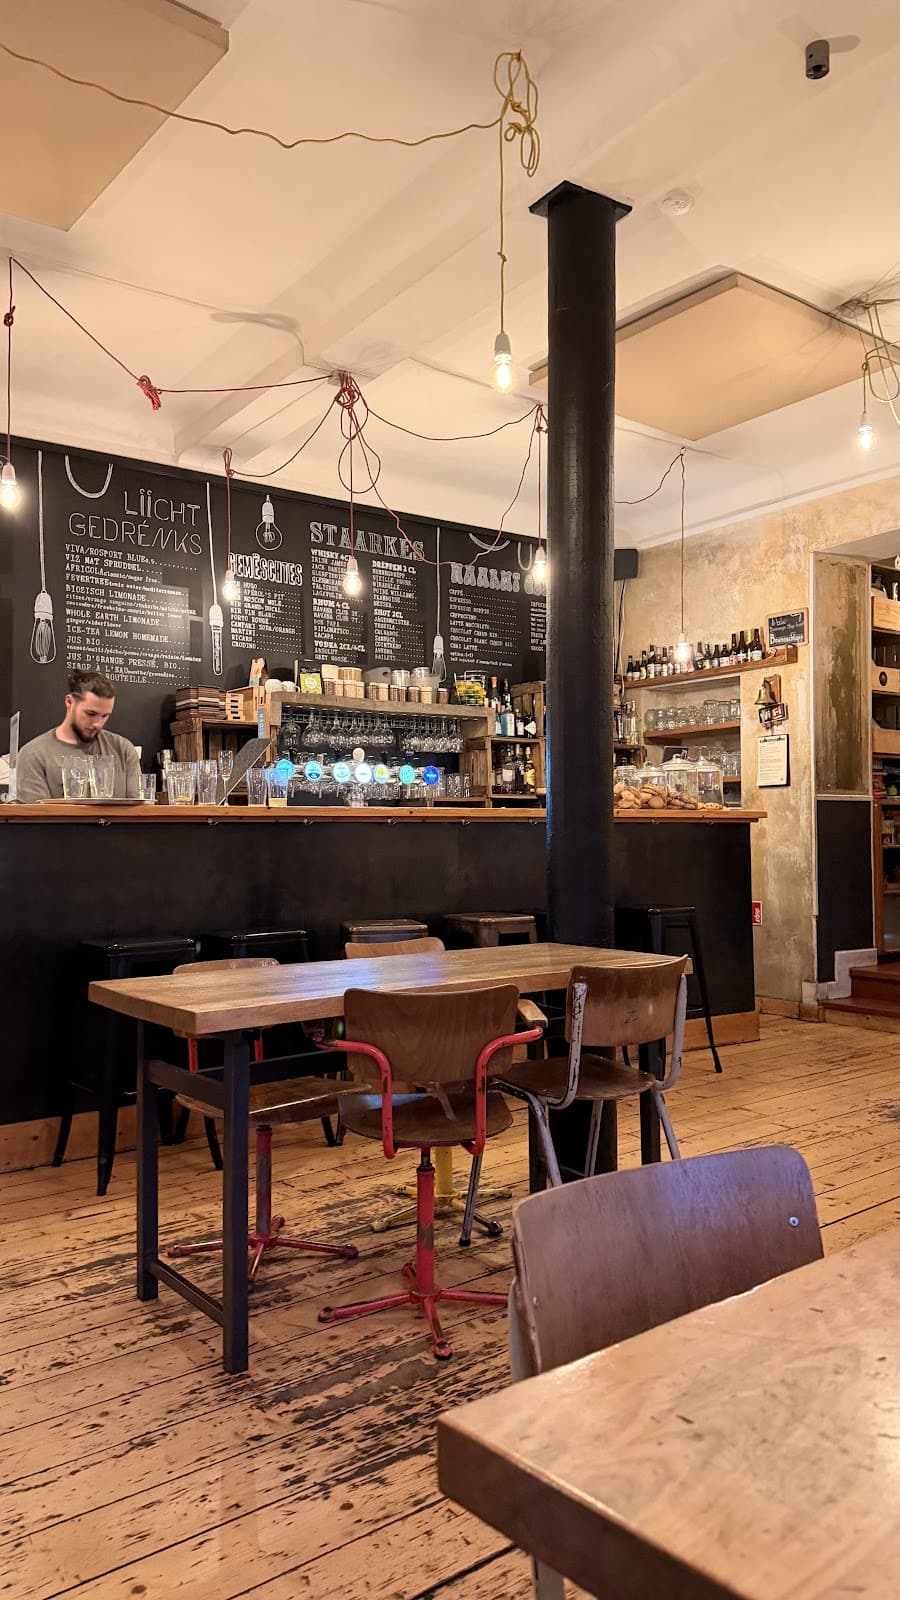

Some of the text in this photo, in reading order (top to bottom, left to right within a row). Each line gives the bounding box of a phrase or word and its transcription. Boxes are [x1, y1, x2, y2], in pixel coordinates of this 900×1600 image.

[309, 521, 425, 562] STAARKES
[66, 544, 123, 560] VIVA/ROSPORT
[66, 572, 109, 586] FEVERTREE
[110, 588, 147, 602] LIMONADE
[66, 608, 161, 627] WHOLE EARTH LIMONADE
[66, 624, 170, 645] ICE-TEA LEMON HOMEMADE
[66, 636, 101, 647] JUS BIO
[66, 652, 82, 662] JUS
[164, 662, 178, 671] BIO
